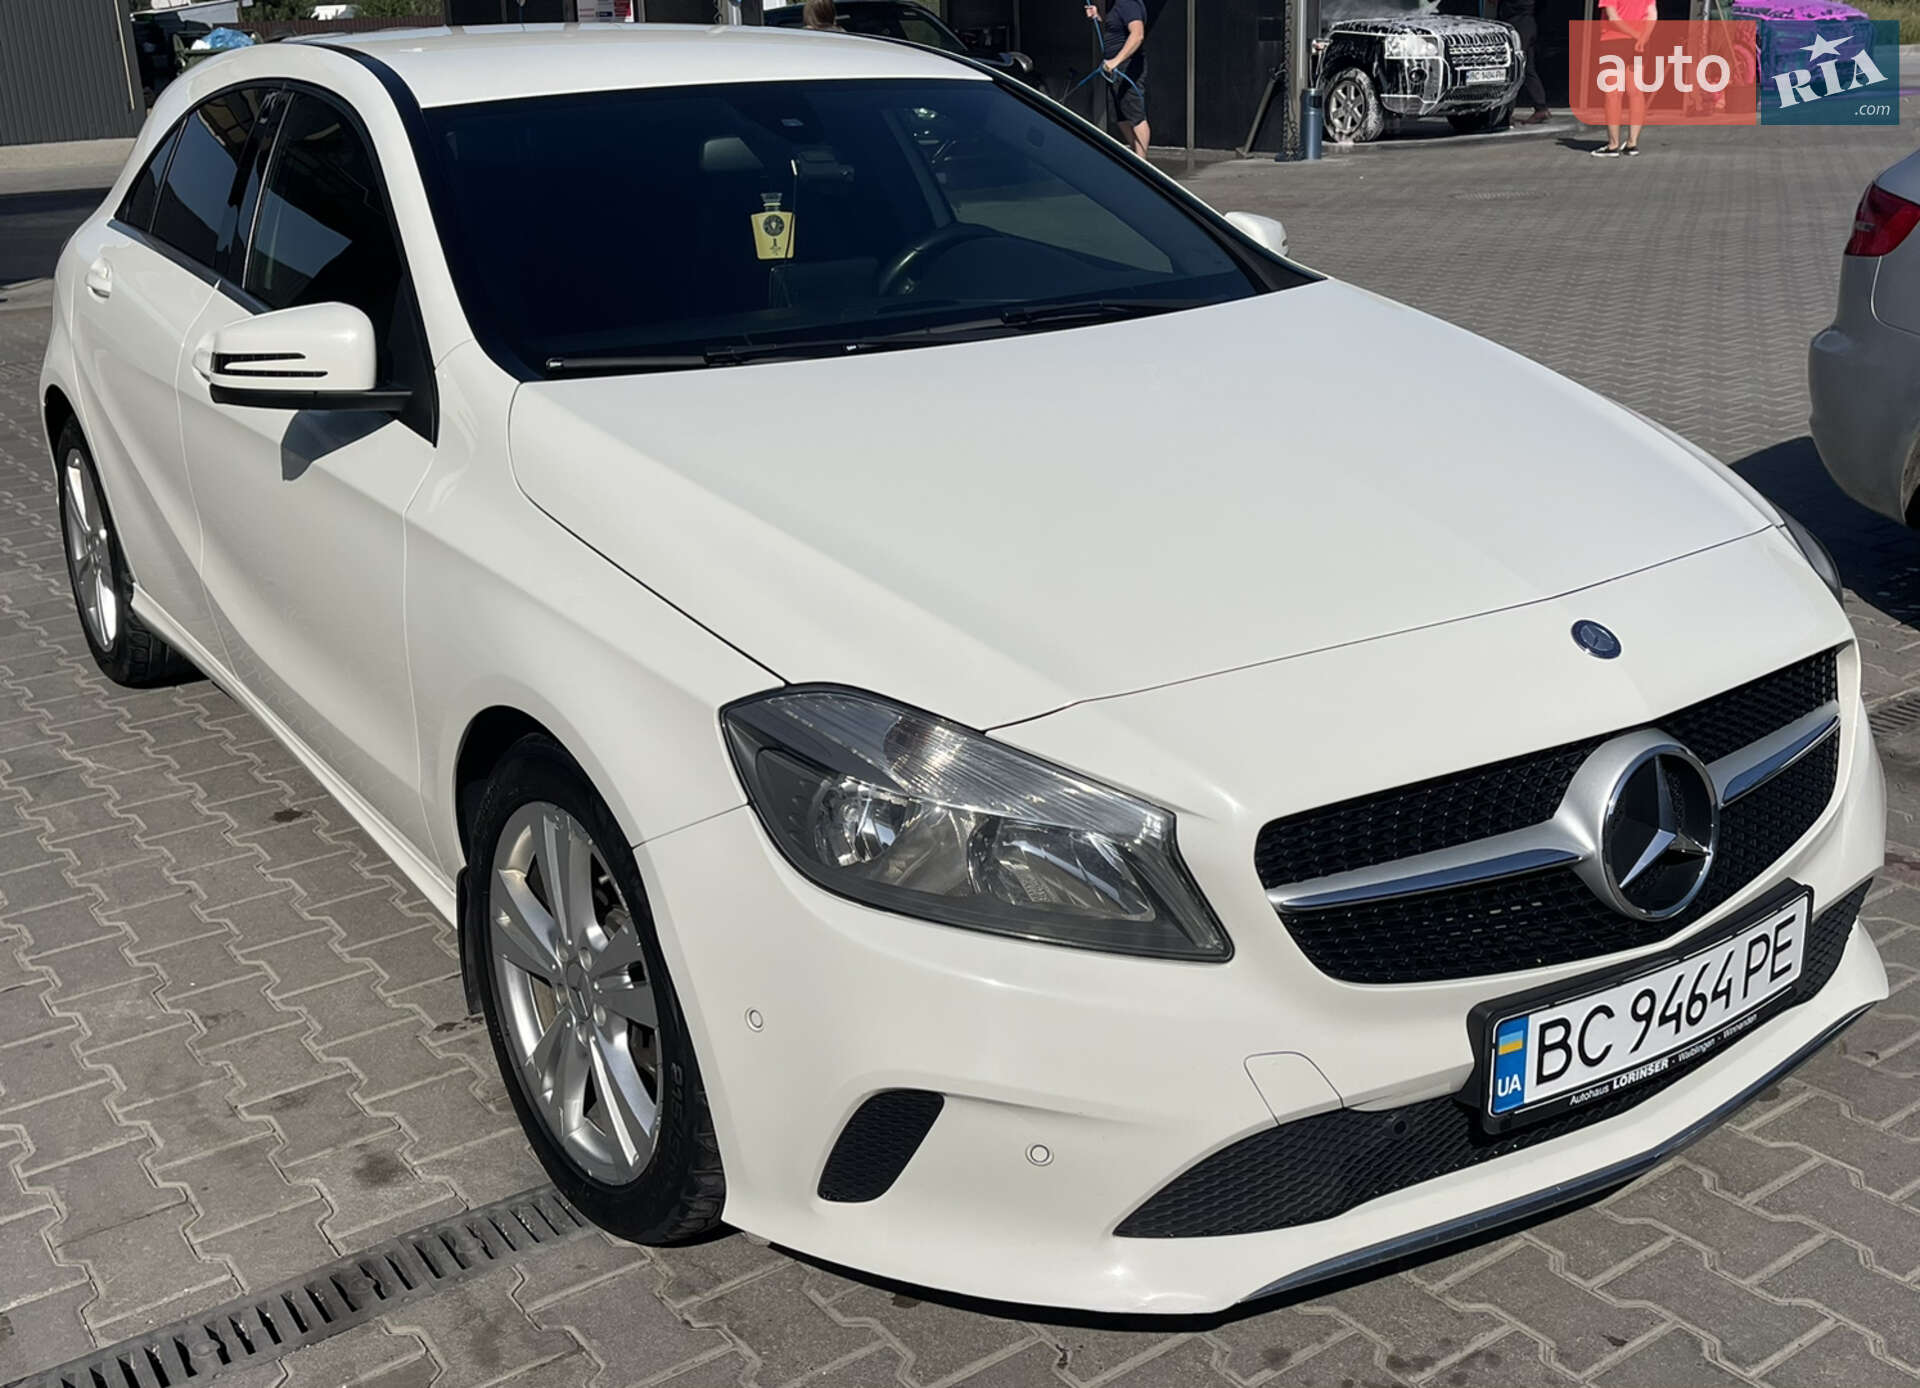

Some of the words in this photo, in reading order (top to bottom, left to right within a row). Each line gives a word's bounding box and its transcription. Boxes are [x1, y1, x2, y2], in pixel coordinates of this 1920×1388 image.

[1536, 1004, 1615, 1085] BC
[1629, 950, 1735, 1054] 9464
[1742, 914, 1797, 1000] PE
[1497, 1073, 1522, 1098] UA
[1569, 1084, 1610, 1106] Autohaus
[1612, 1056, 1670, 1090] LORINSER
